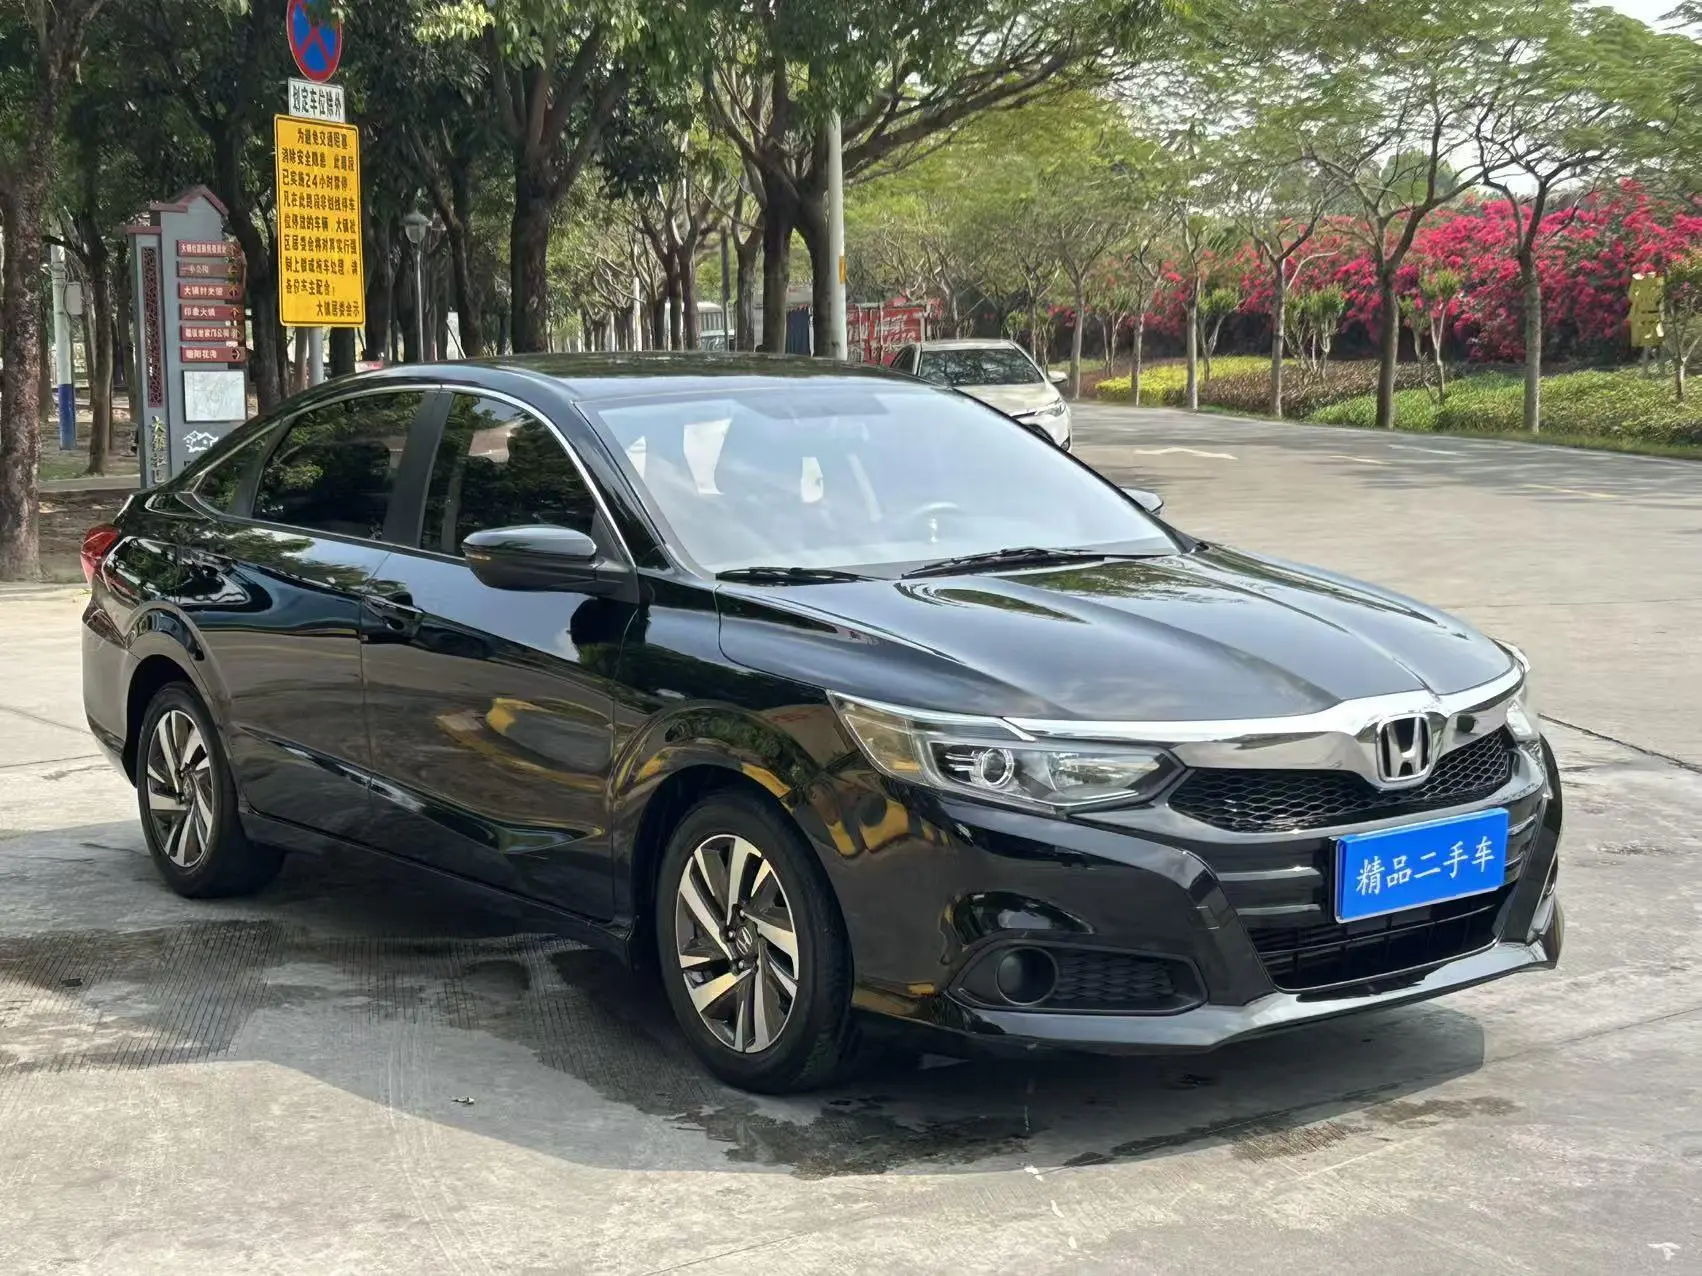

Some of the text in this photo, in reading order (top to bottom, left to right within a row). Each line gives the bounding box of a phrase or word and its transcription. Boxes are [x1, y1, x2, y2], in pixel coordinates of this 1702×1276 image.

[292, 84, 342, 119] 划定车位除外
[281, 147, 355, 171] 消除安全隐患此路段
[1356, 835, 1496, 896] 精品二手车
